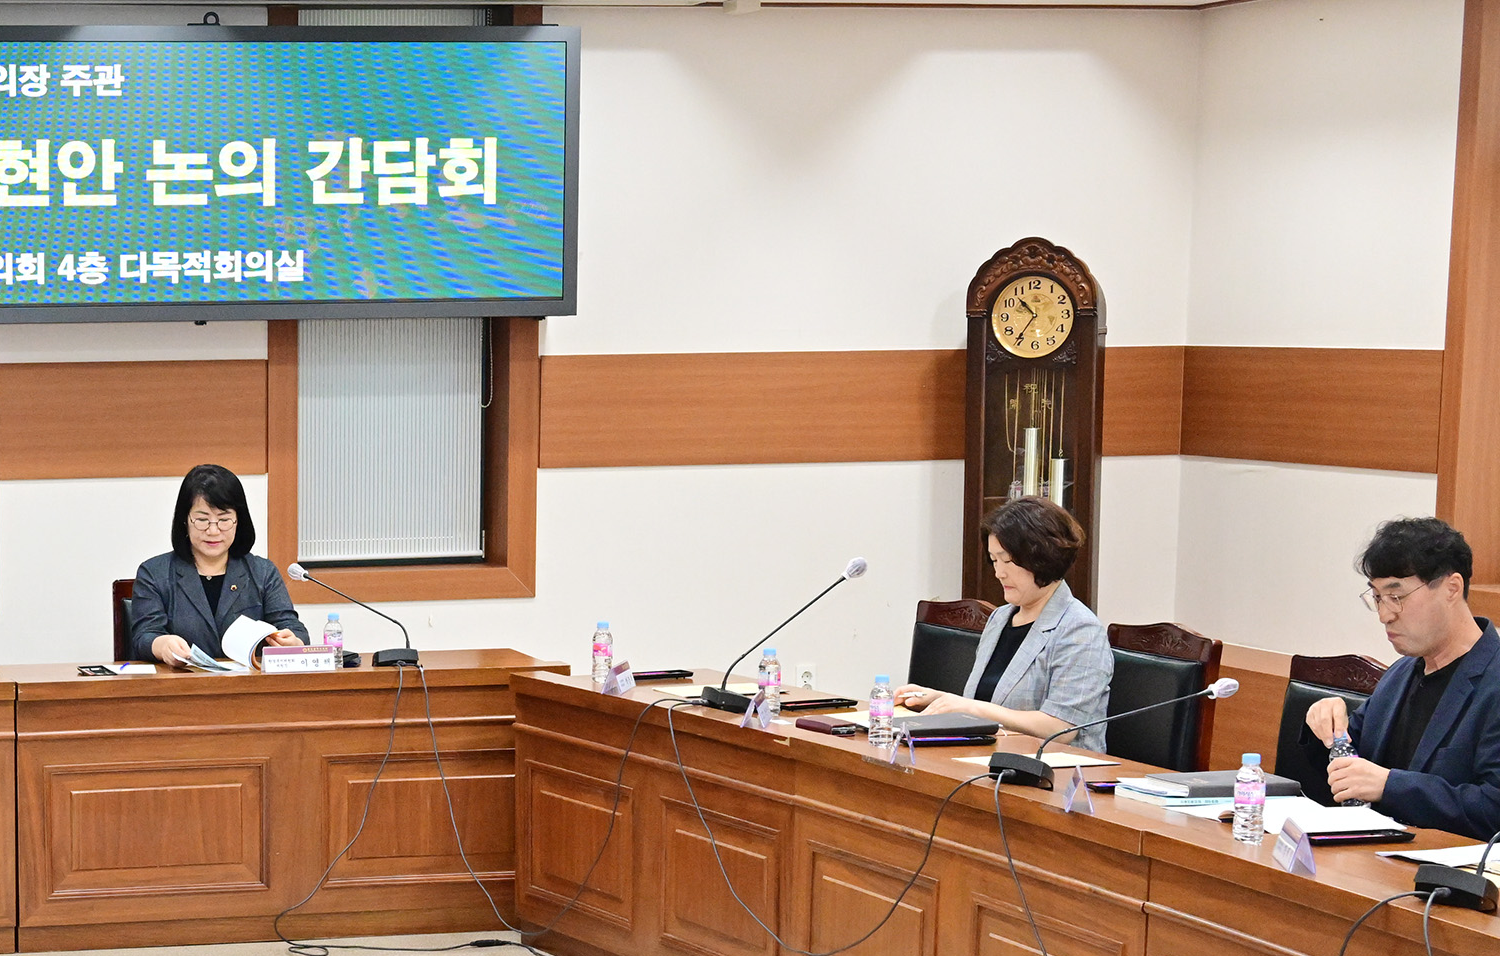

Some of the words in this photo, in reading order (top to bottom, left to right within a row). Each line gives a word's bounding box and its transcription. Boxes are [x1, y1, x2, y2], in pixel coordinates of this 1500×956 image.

[60, 63, 125, 97] 주관
[145, 138, 277, 208] 논의
[305, 137, 499, 206] 간담회
[57, 252, 109, 285] 4층
[119, 250, 305, 284] 다목적회의실
[1028, 279, 1042, 290] 12
[1050, 284, 1055, 293] 1
[1014, 286, 1024, 296] 11
[1004, 297, 1015, 308] 10
[1057, 294, 1067, 304] 2
[1001, 312, 1010, 322] 9
[1061, 309, 1071, 319] 3
[1004, 326, 1014, 336] 8
[1056, 323, 1066, 333] 4
[1031, 340, 1040, 350] 6
[1046, 335, 1056, 345] 5
